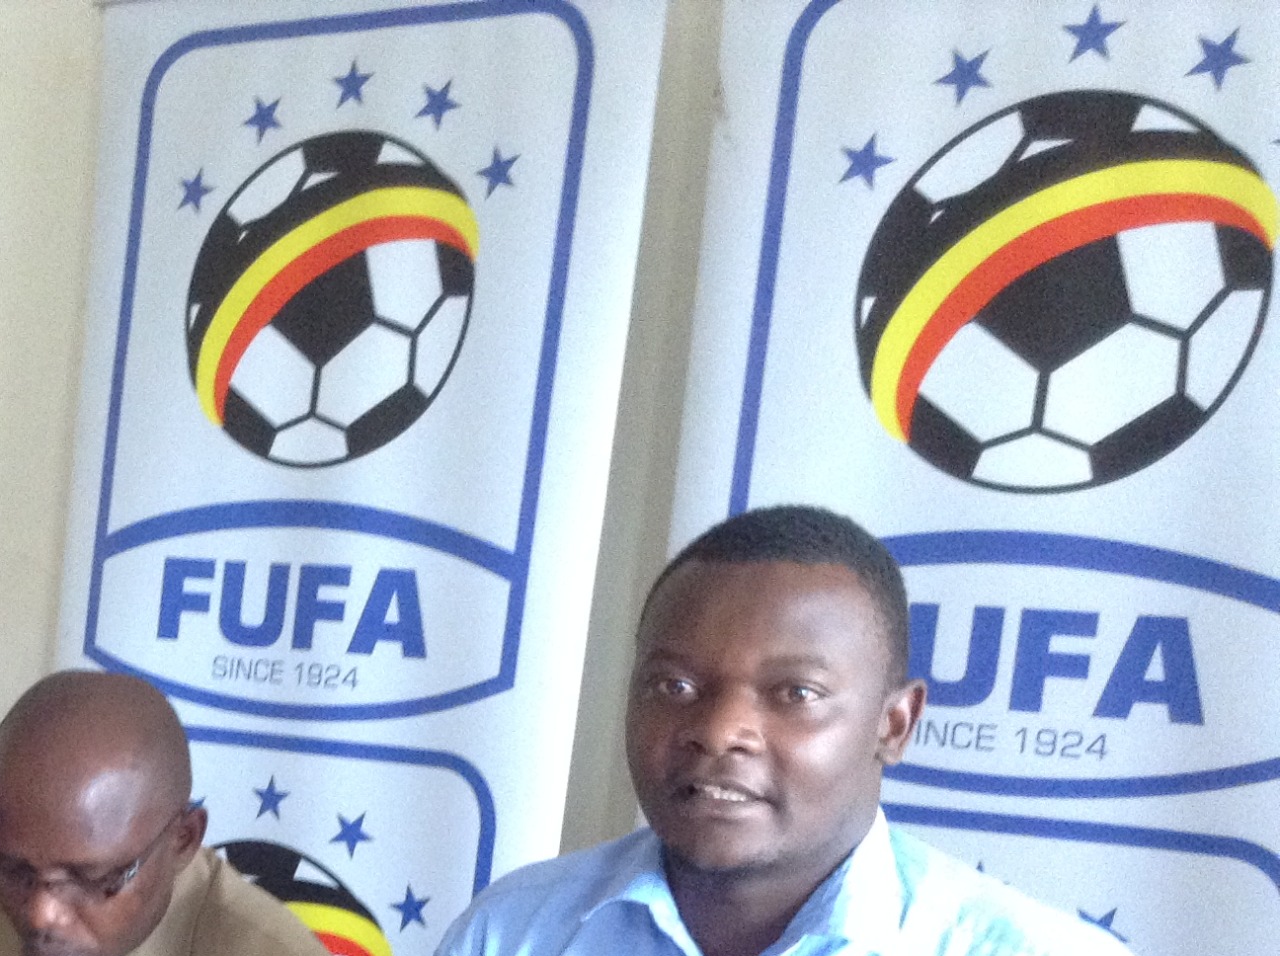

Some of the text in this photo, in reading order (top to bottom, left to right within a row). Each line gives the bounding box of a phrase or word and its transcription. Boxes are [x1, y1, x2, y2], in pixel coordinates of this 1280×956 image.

[156, 556, 427, 659] FUFA
[211, 654, 359, 690] SINCE 1924
[907, 602, 1205, 726] UFA
[914, 719, 1108, 761] INCE 1924
